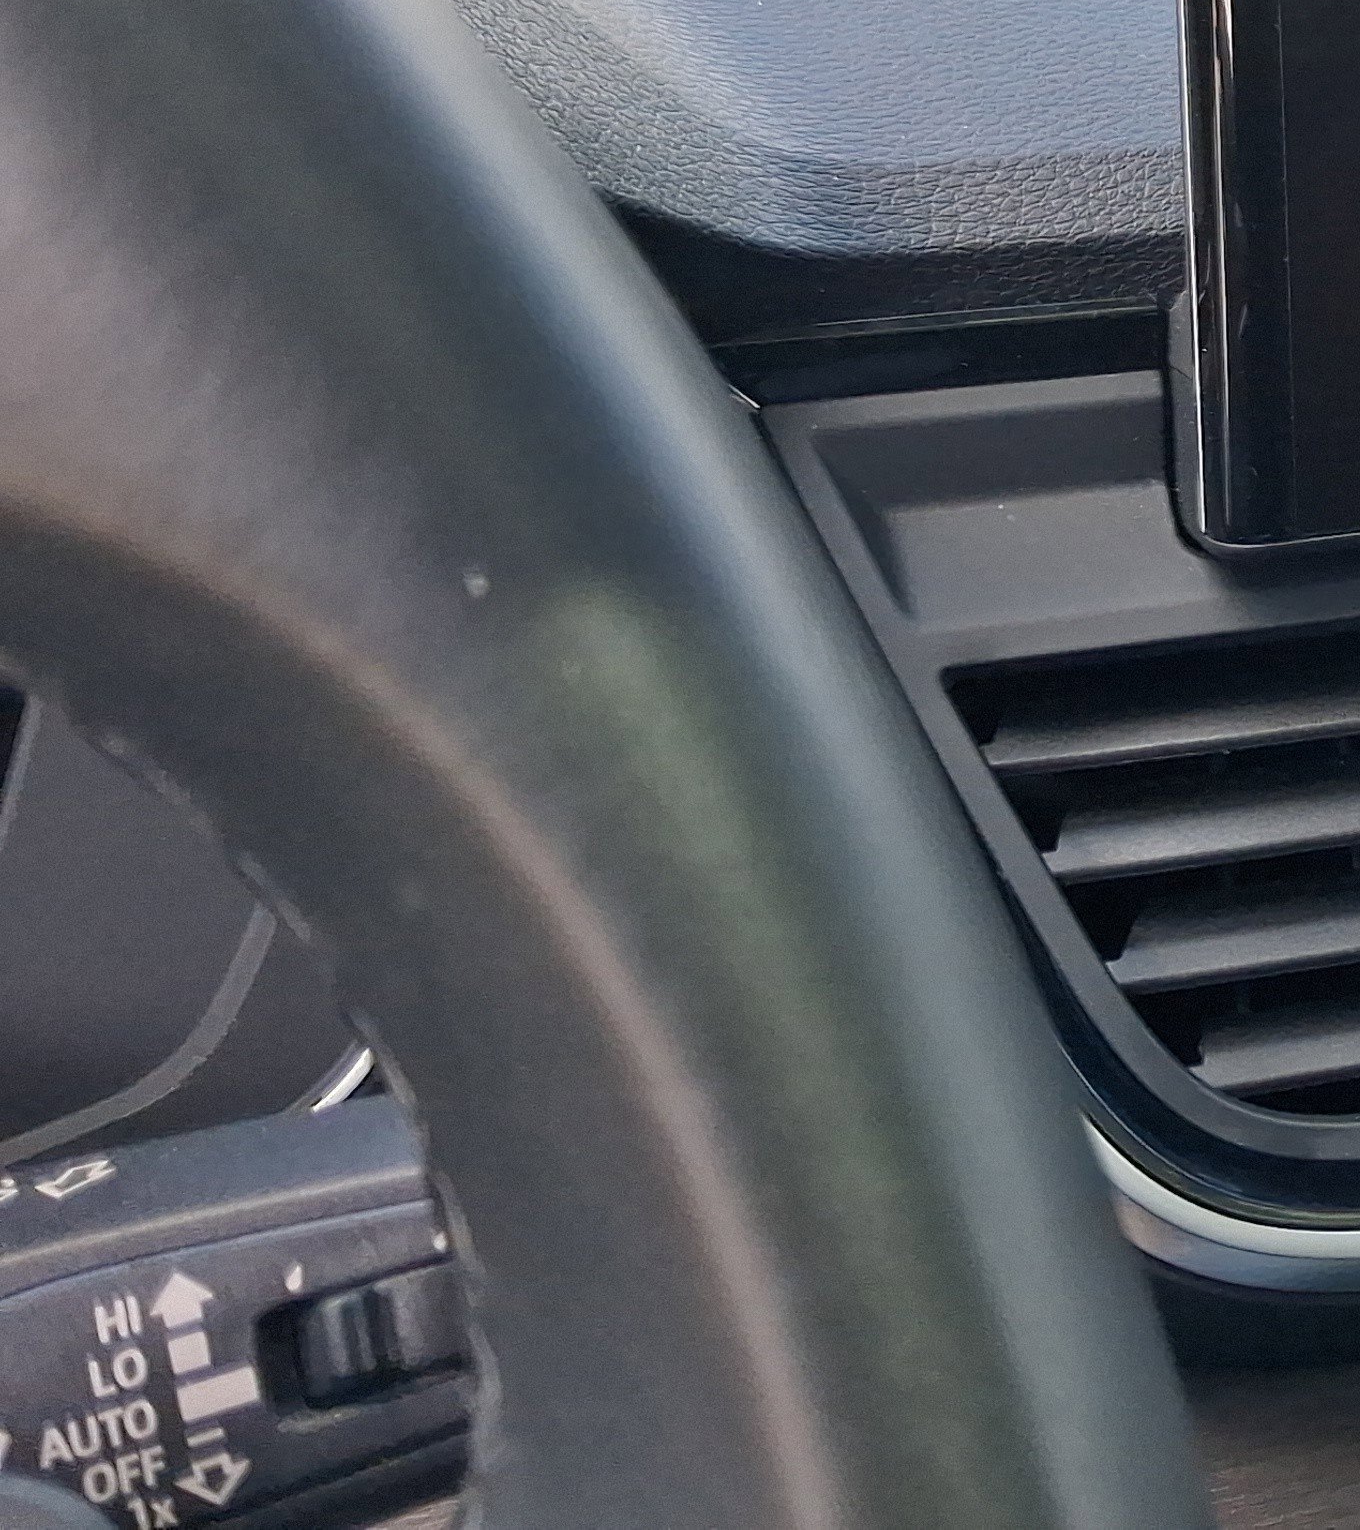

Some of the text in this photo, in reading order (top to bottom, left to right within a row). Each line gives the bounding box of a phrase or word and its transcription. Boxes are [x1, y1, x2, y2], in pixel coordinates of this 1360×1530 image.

[94, 1294, 144, 1345] HI
[87, 1348, 148, 1398] LO
[38, 1399, 157, 1469] AUTO
[83, 1446, 166, 1505] OFF
